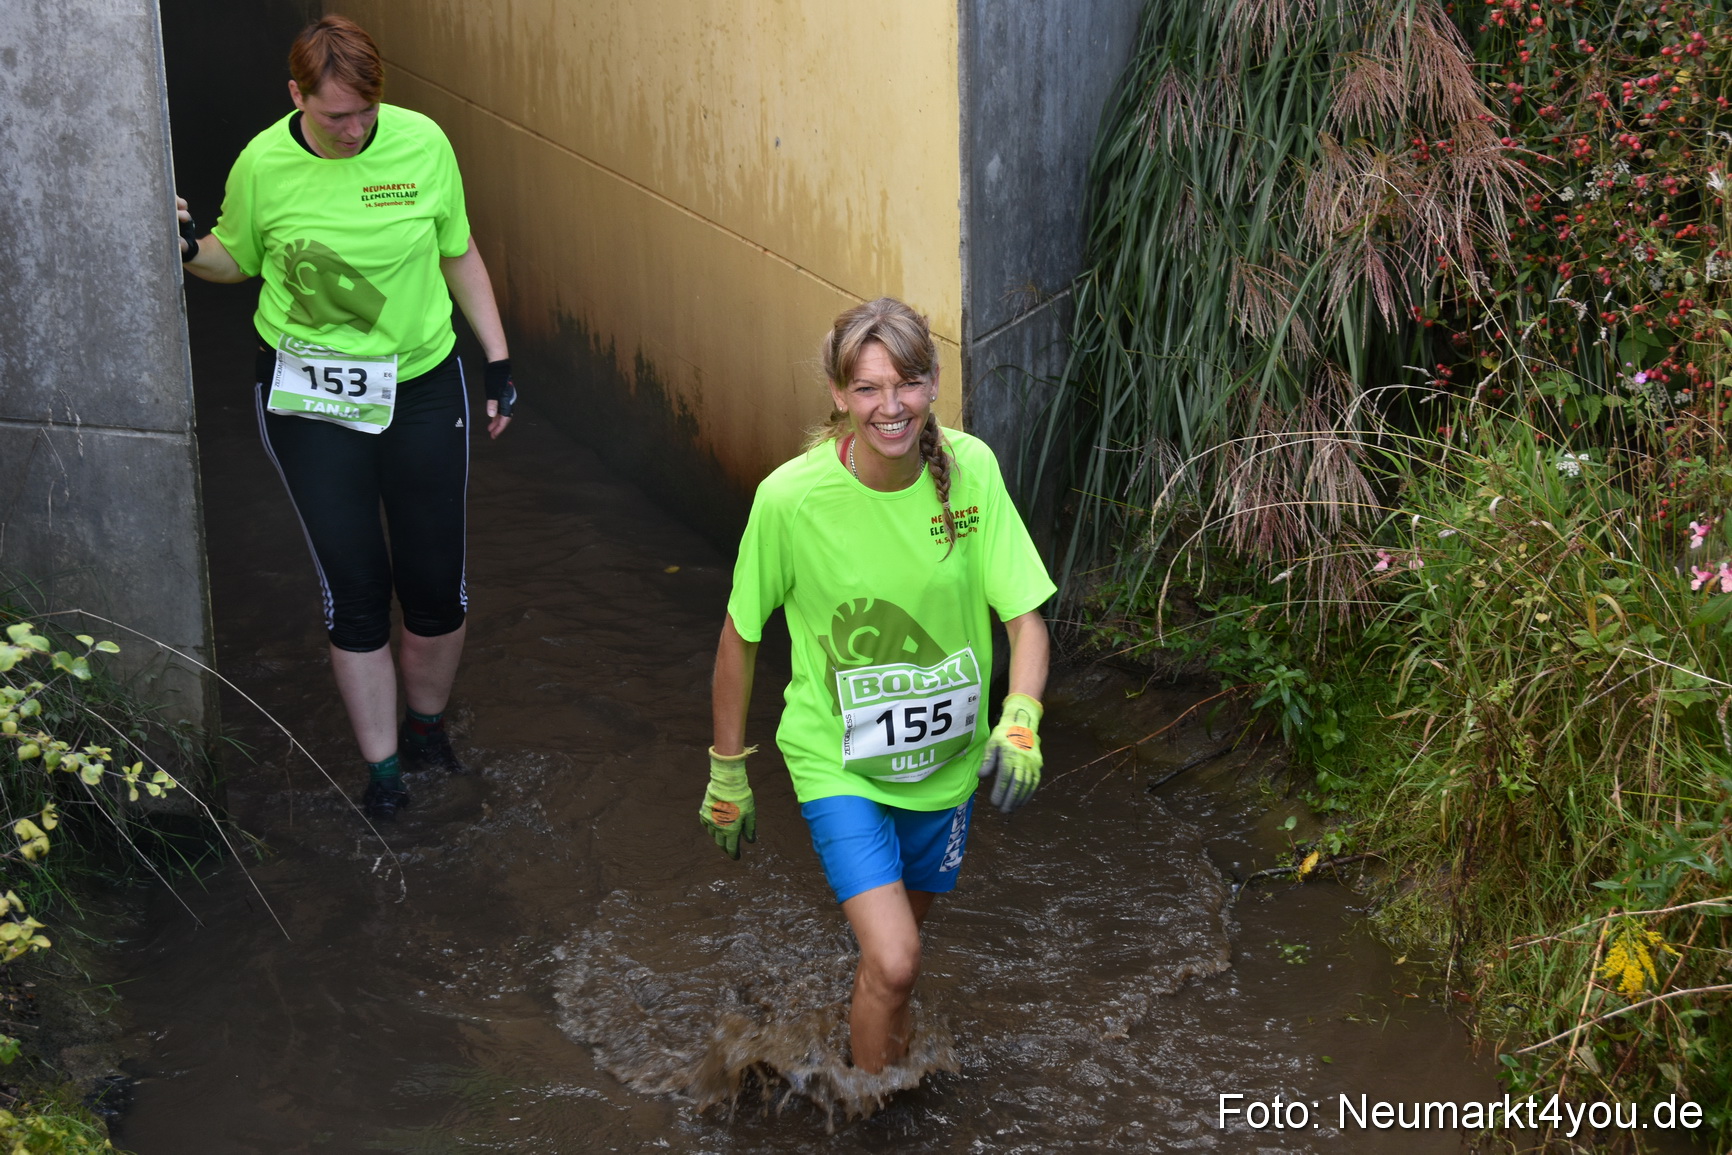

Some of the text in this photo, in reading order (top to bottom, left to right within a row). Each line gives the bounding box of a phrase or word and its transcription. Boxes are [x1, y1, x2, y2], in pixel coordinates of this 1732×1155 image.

[361, 191, 418, 201] ELEMENTELAUF
[363, 183, 416, 193] NEUMARKTER
[302, 366, 368, 397] 153
[302, 399, 360, 419] TANJA
[849, 657, 970, 704] BOCK
[876, 699, 953, 746] 155
[891, 749, 935, 772] ULLI
